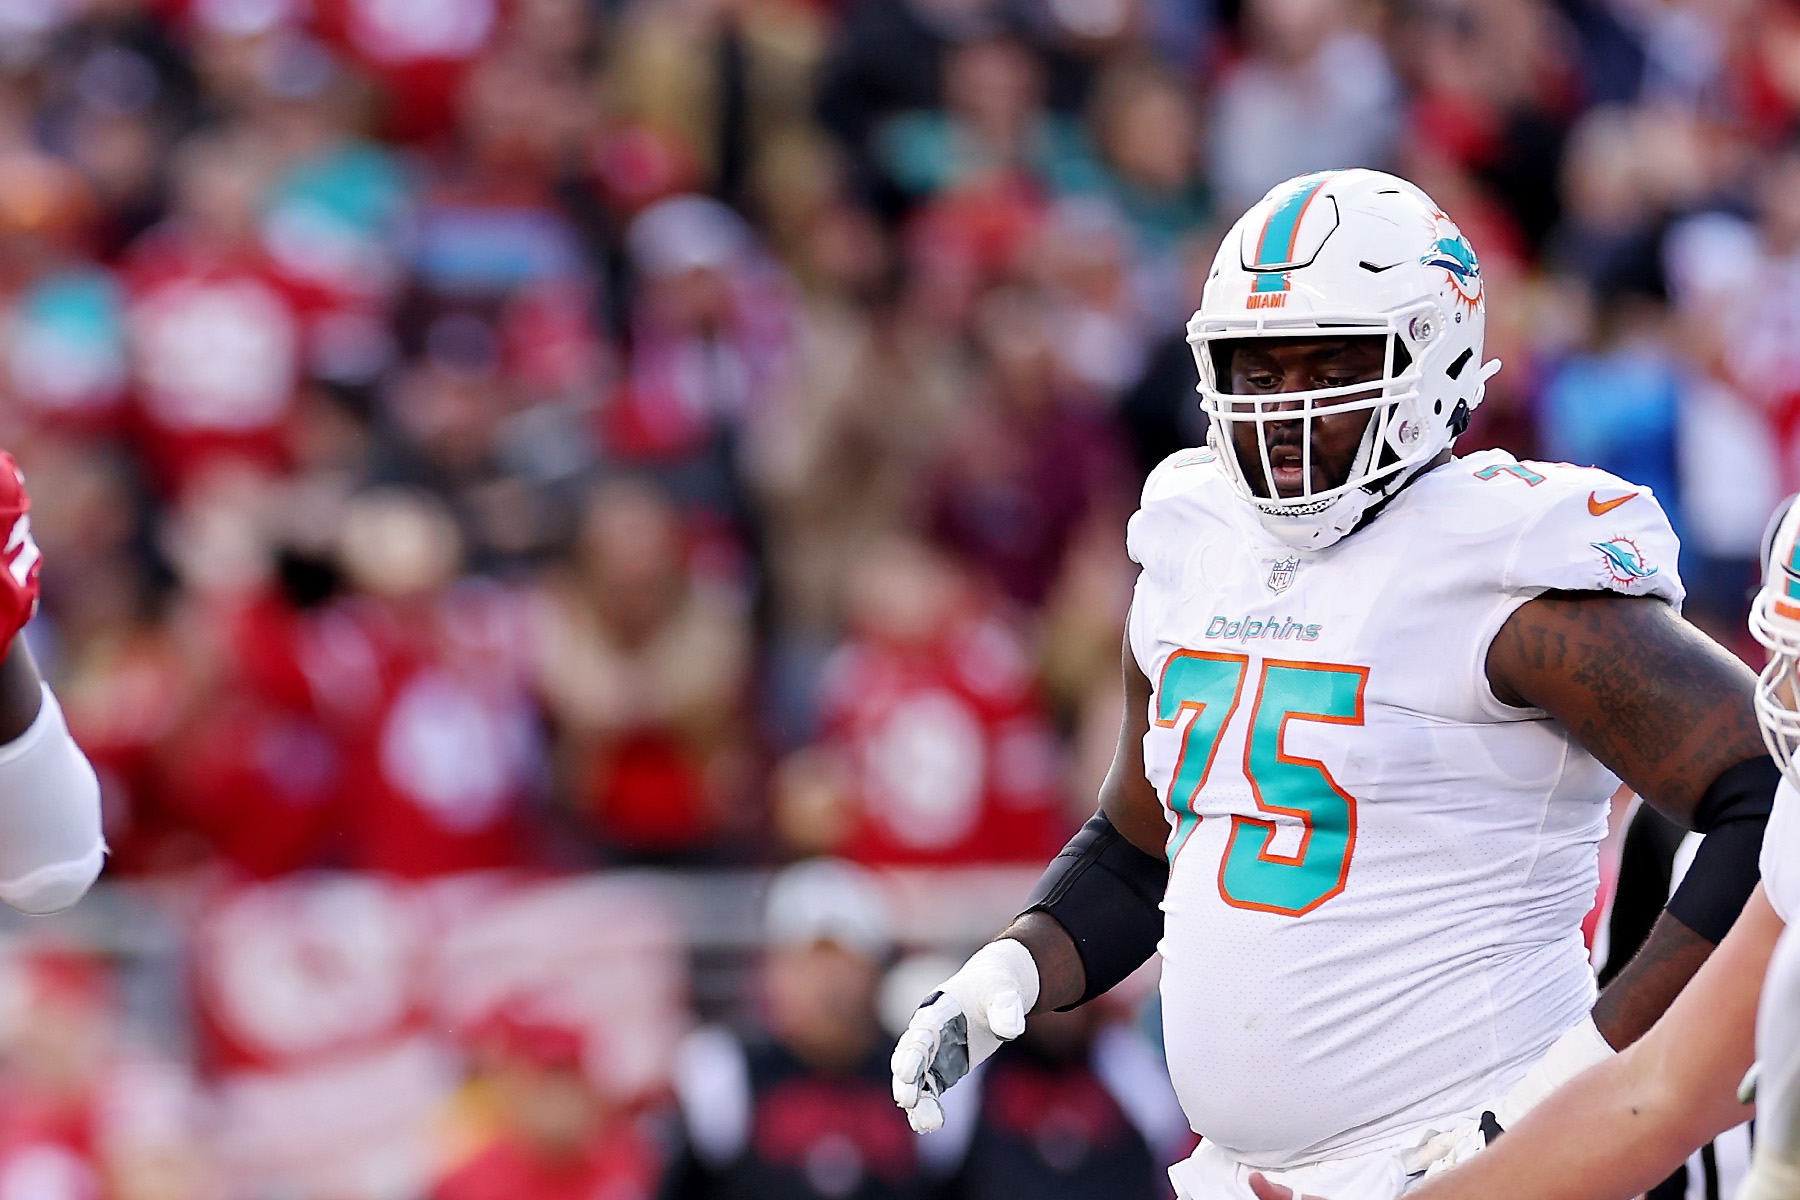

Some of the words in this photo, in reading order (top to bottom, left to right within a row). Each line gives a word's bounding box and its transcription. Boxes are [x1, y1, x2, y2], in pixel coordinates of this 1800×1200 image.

[1246, 293, 1287, 310] MIAMI
[1270, 572, 1289, 587] NFL
[1205, 615, 1323, 645] Dolphins
[1155, 648, 1370, 918] 75
